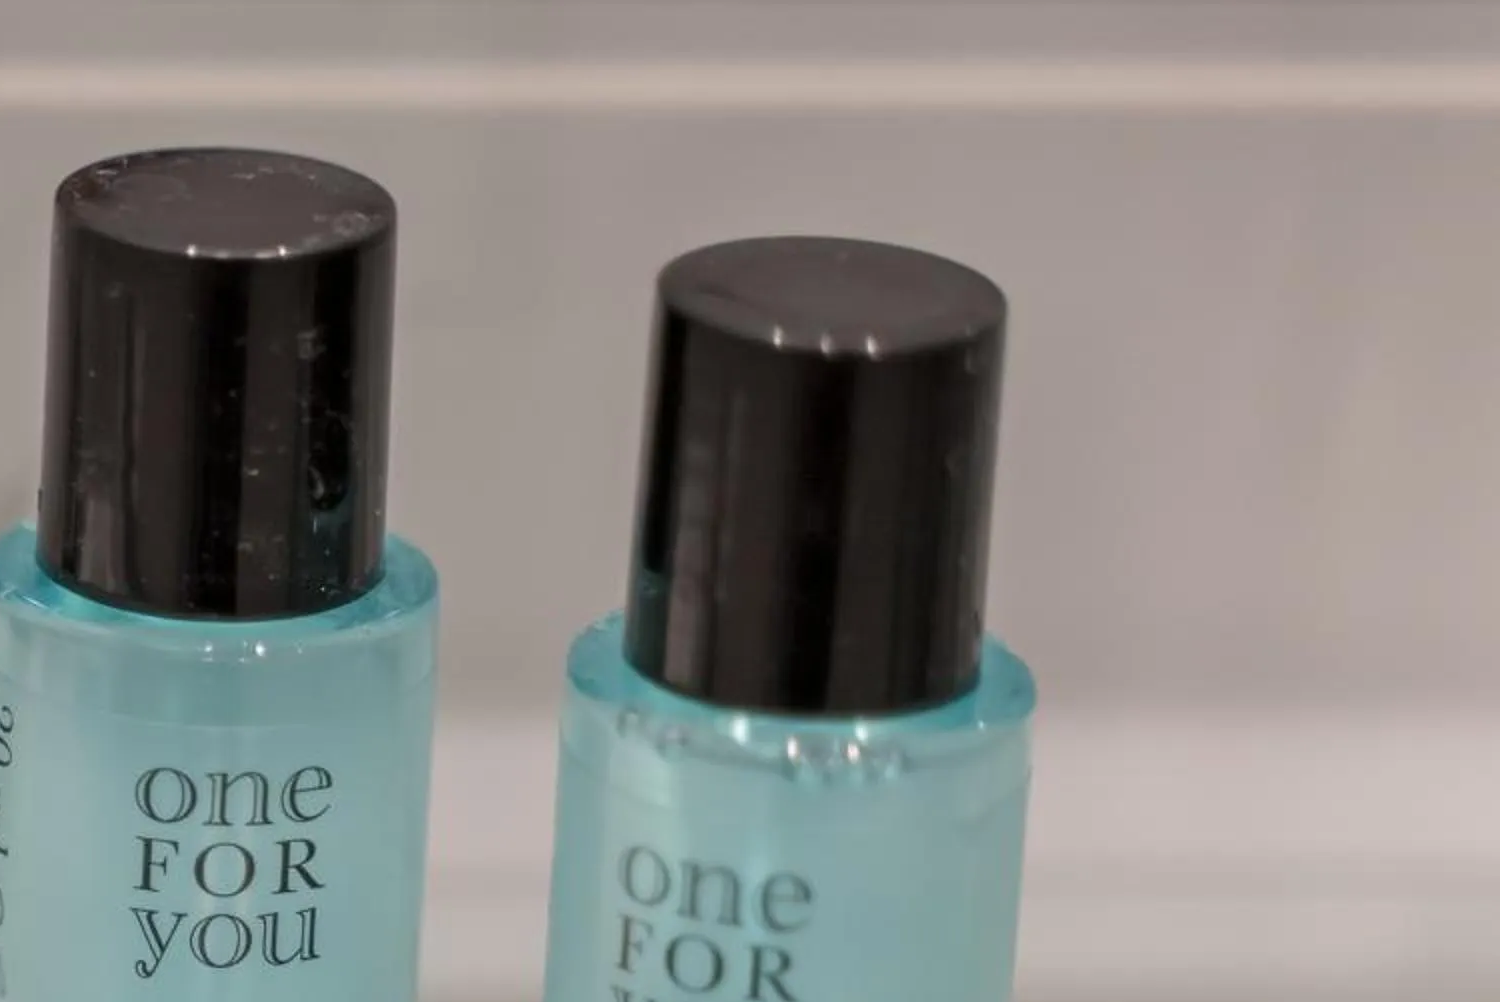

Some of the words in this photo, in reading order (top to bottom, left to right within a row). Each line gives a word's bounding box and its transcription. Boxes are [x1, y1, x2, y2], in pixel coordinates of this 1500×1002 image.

[134, 763, 333, 827] one
[132, 836, 326, 899] FOR
[618, 844, 814, 934] one
[130, 906, 320, 979] you
